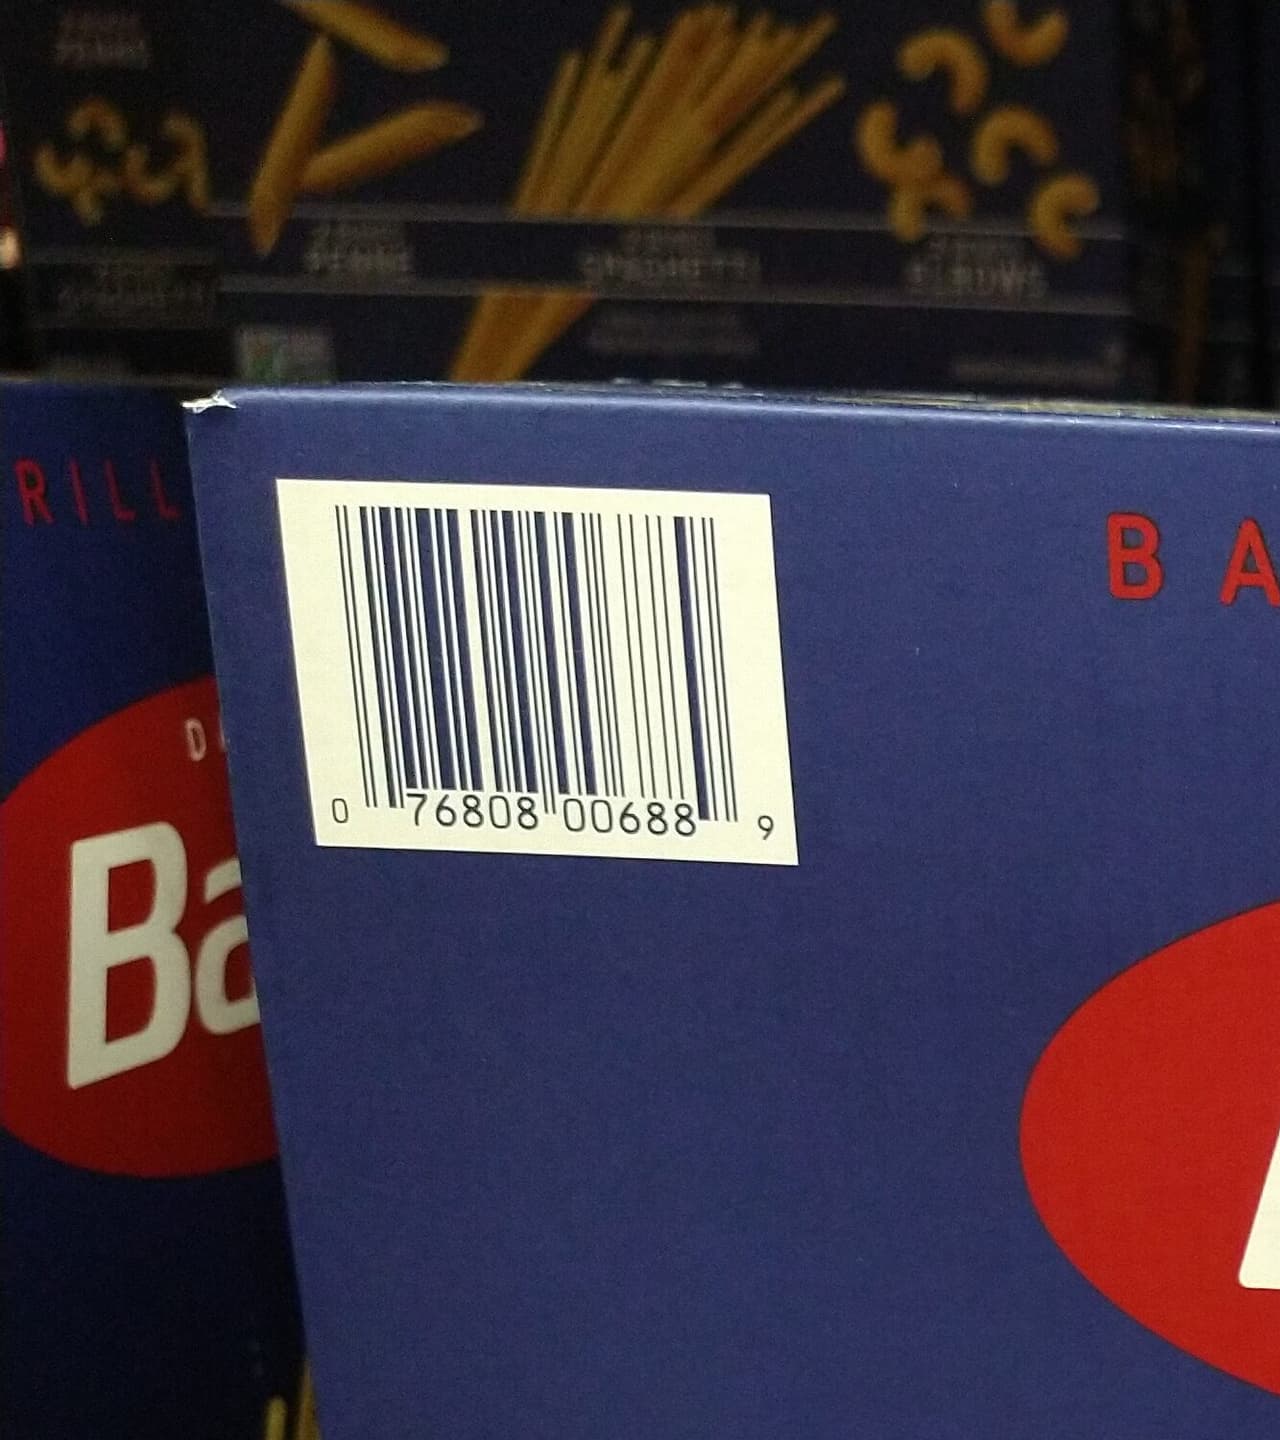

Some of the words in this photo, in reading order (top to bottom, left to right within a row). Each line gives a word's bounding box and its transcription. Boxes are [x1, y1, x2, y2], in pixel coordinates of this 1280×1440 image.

[332, 797, 349, 824] 0
[406, 794, 540, 829] 76808
[563, 798, 697, 837] 00688
[757, 815, 775, 841] 9
